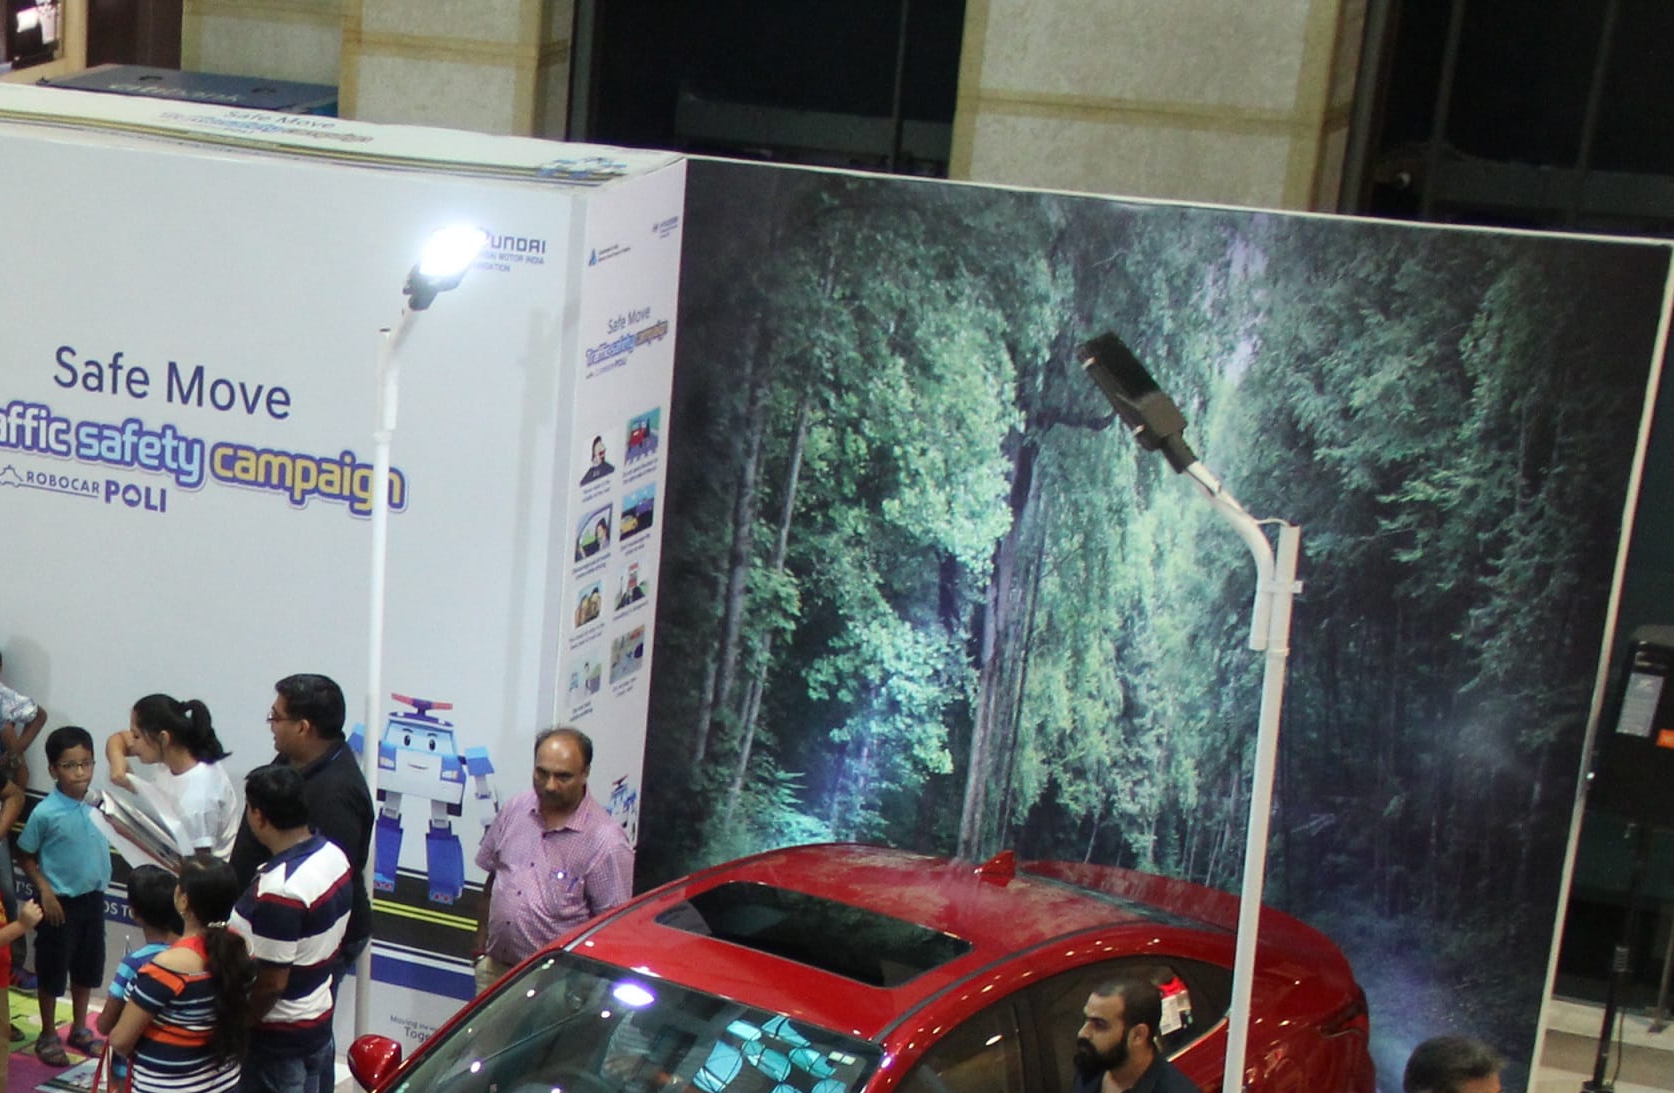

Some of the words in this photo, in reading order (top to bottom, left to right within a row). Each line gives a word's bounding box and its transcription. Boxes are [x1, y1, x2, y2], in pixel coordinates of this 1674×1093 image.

[486, 232, 546, 254] UNDAI
[53, 345, 151, 400] Safe
[166, 361, 292, 420] Move
[75, 418, 206, 488] safety
[210, 440, 406, 518] campaign
[26, 470, 100, 494] ROBOCAR
[104, 479, 166, 513] POLI
[15, 880, 33, 895] T'S
[390, 1015, 418, 1029] Moving
